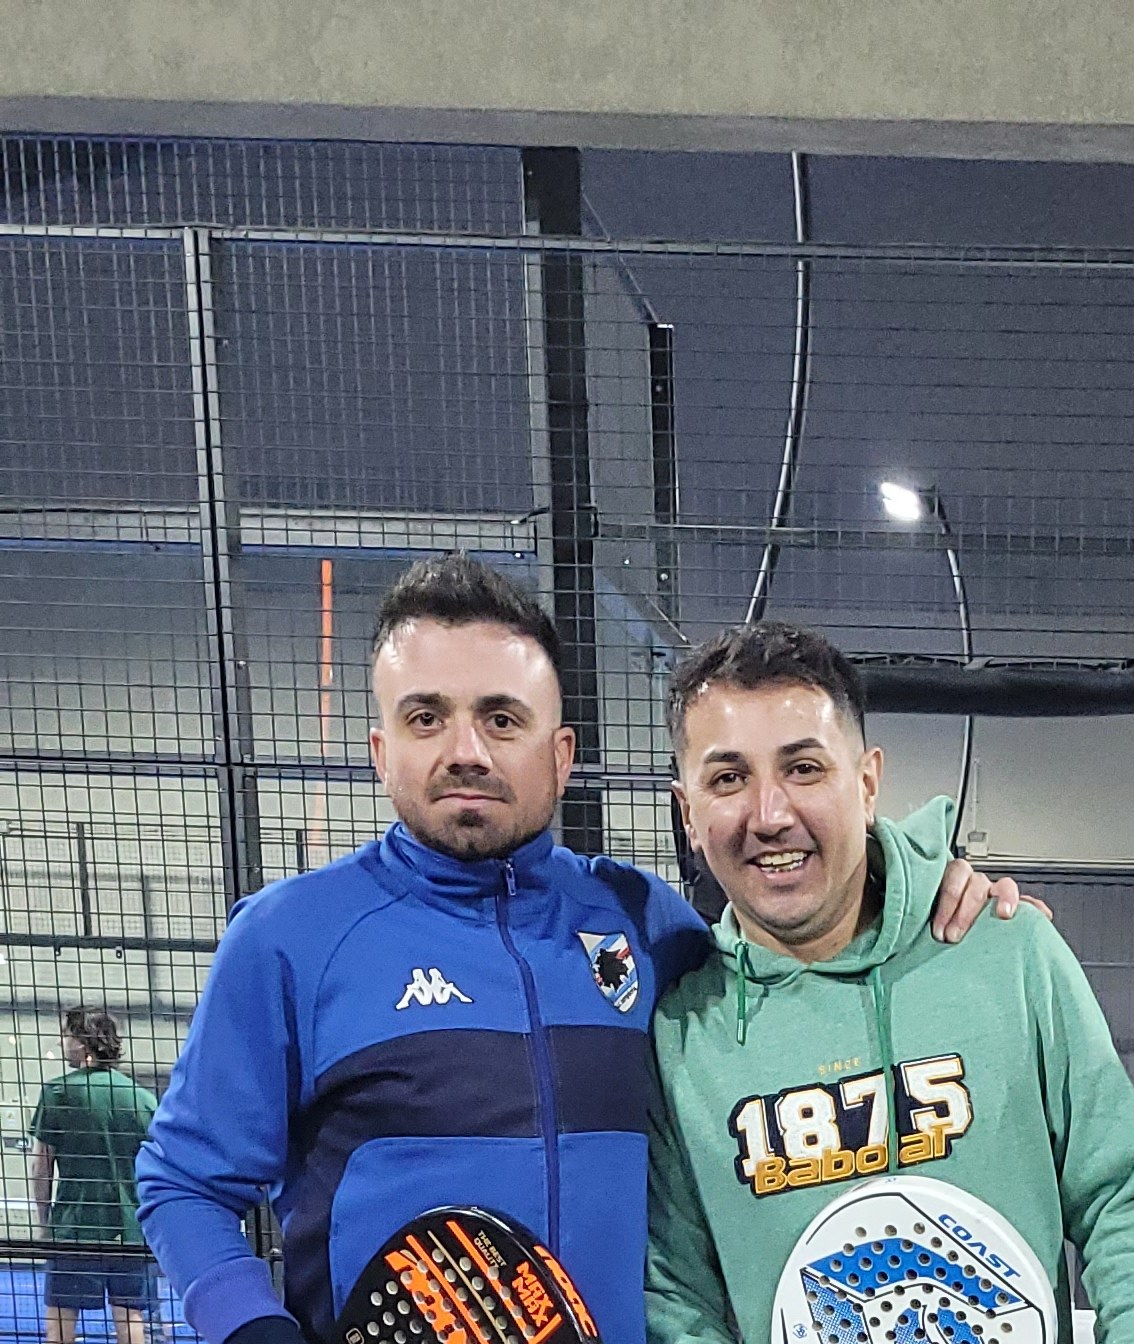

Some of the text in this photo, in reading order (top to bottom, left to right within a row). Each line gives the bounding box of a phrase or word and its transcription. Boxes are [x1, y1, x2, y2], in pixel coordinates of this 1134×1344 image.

[736, 1056, 972, 1177] 1875
[755, 1122, 946, 1194] Baboat
[477, 1229, 508, 1267] THE BEST
[938, 1213, 1021, 1278] COAST
[511, 1276, 548, 1327] MAX
[516, 1261, 554, 1308] MAX
